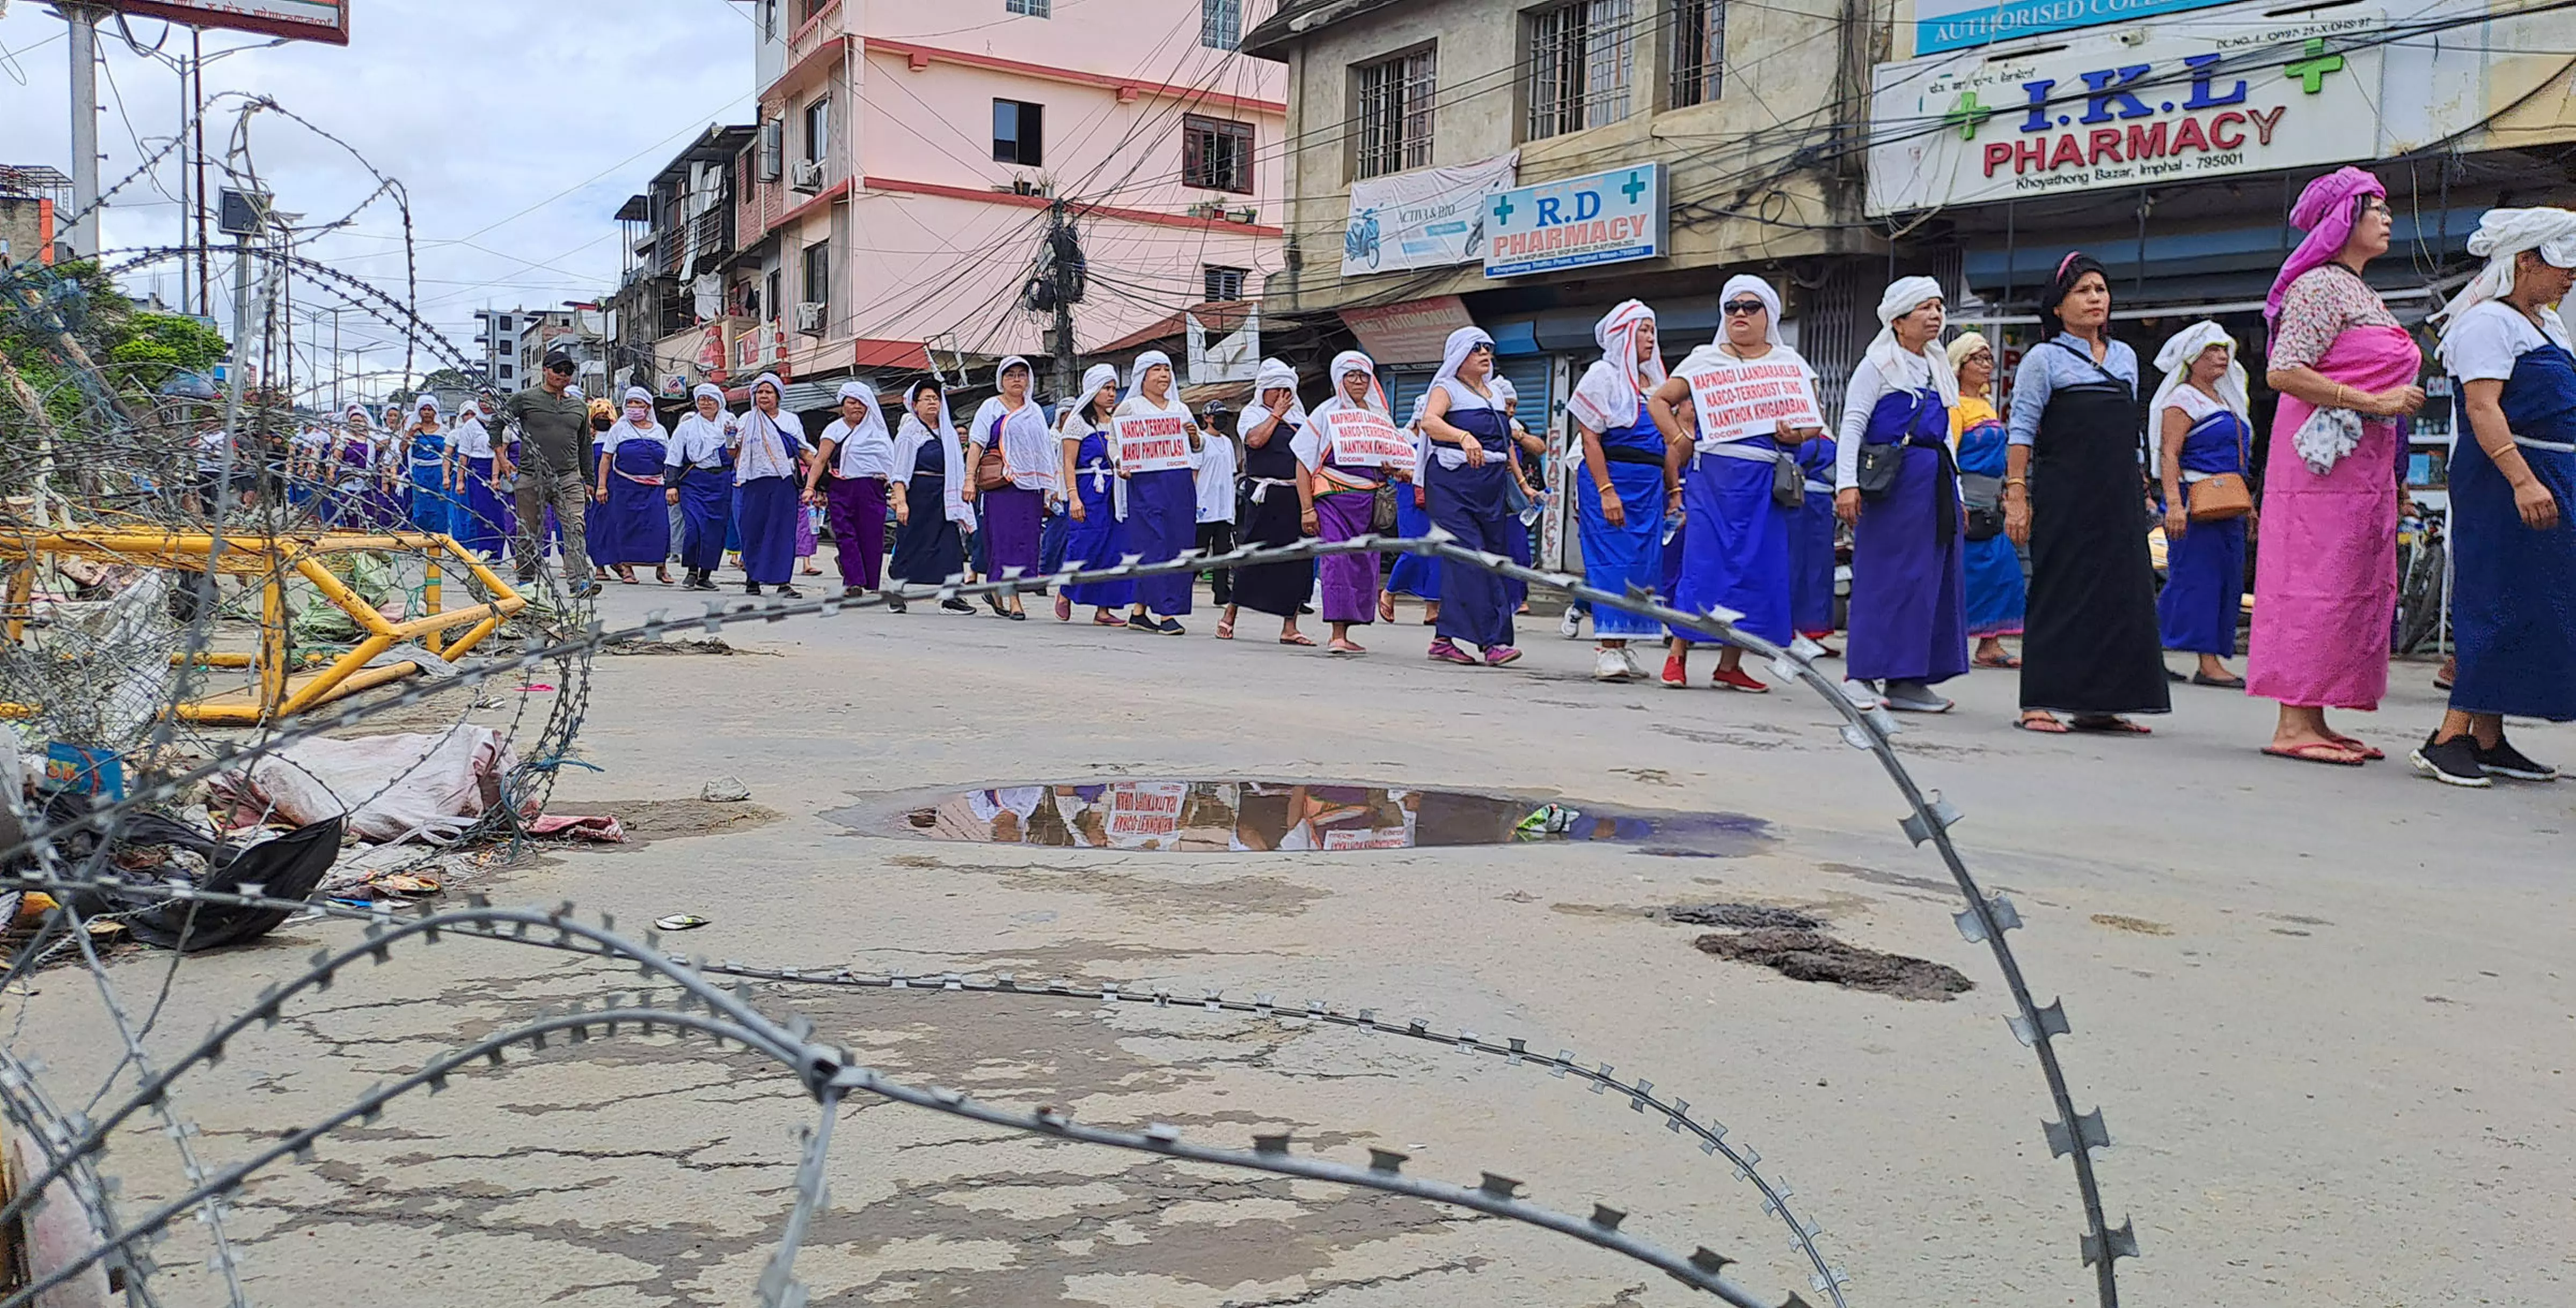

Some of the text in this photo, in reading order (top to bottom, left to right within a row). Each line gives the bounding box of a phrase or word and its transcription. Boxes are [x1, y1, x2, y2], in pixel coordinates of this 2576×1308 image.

[1934, 0, 2085, 43] AUTHORISED
[2019, 53, 2247, 133] I.K.L
[1983, 106, 2286, 178] PHARMACY
[2016, 173, 2089, 190] Khoyathong
[2095, 167, 2134, 181] Bazar,
[2139, 158, 2183, 178] Imphal
[2196, 152, 2244, 170] 795001
[1535, 190, 1601, 227] R.D
[1493, 213, 1648, 258] PHARMACY
[1704, 381, 1781, 408] NARCO-TERRORIST
[1120, 417, 1182, 439] NARCO-TERRORISM
[1707, 406, 1752, 429] TAANTHOK
[1787, 416, 1817, 424] OCOMI
[1708, 428, 1744, 440] COCOMI
[1122, 443, 1140, 461] MARU
